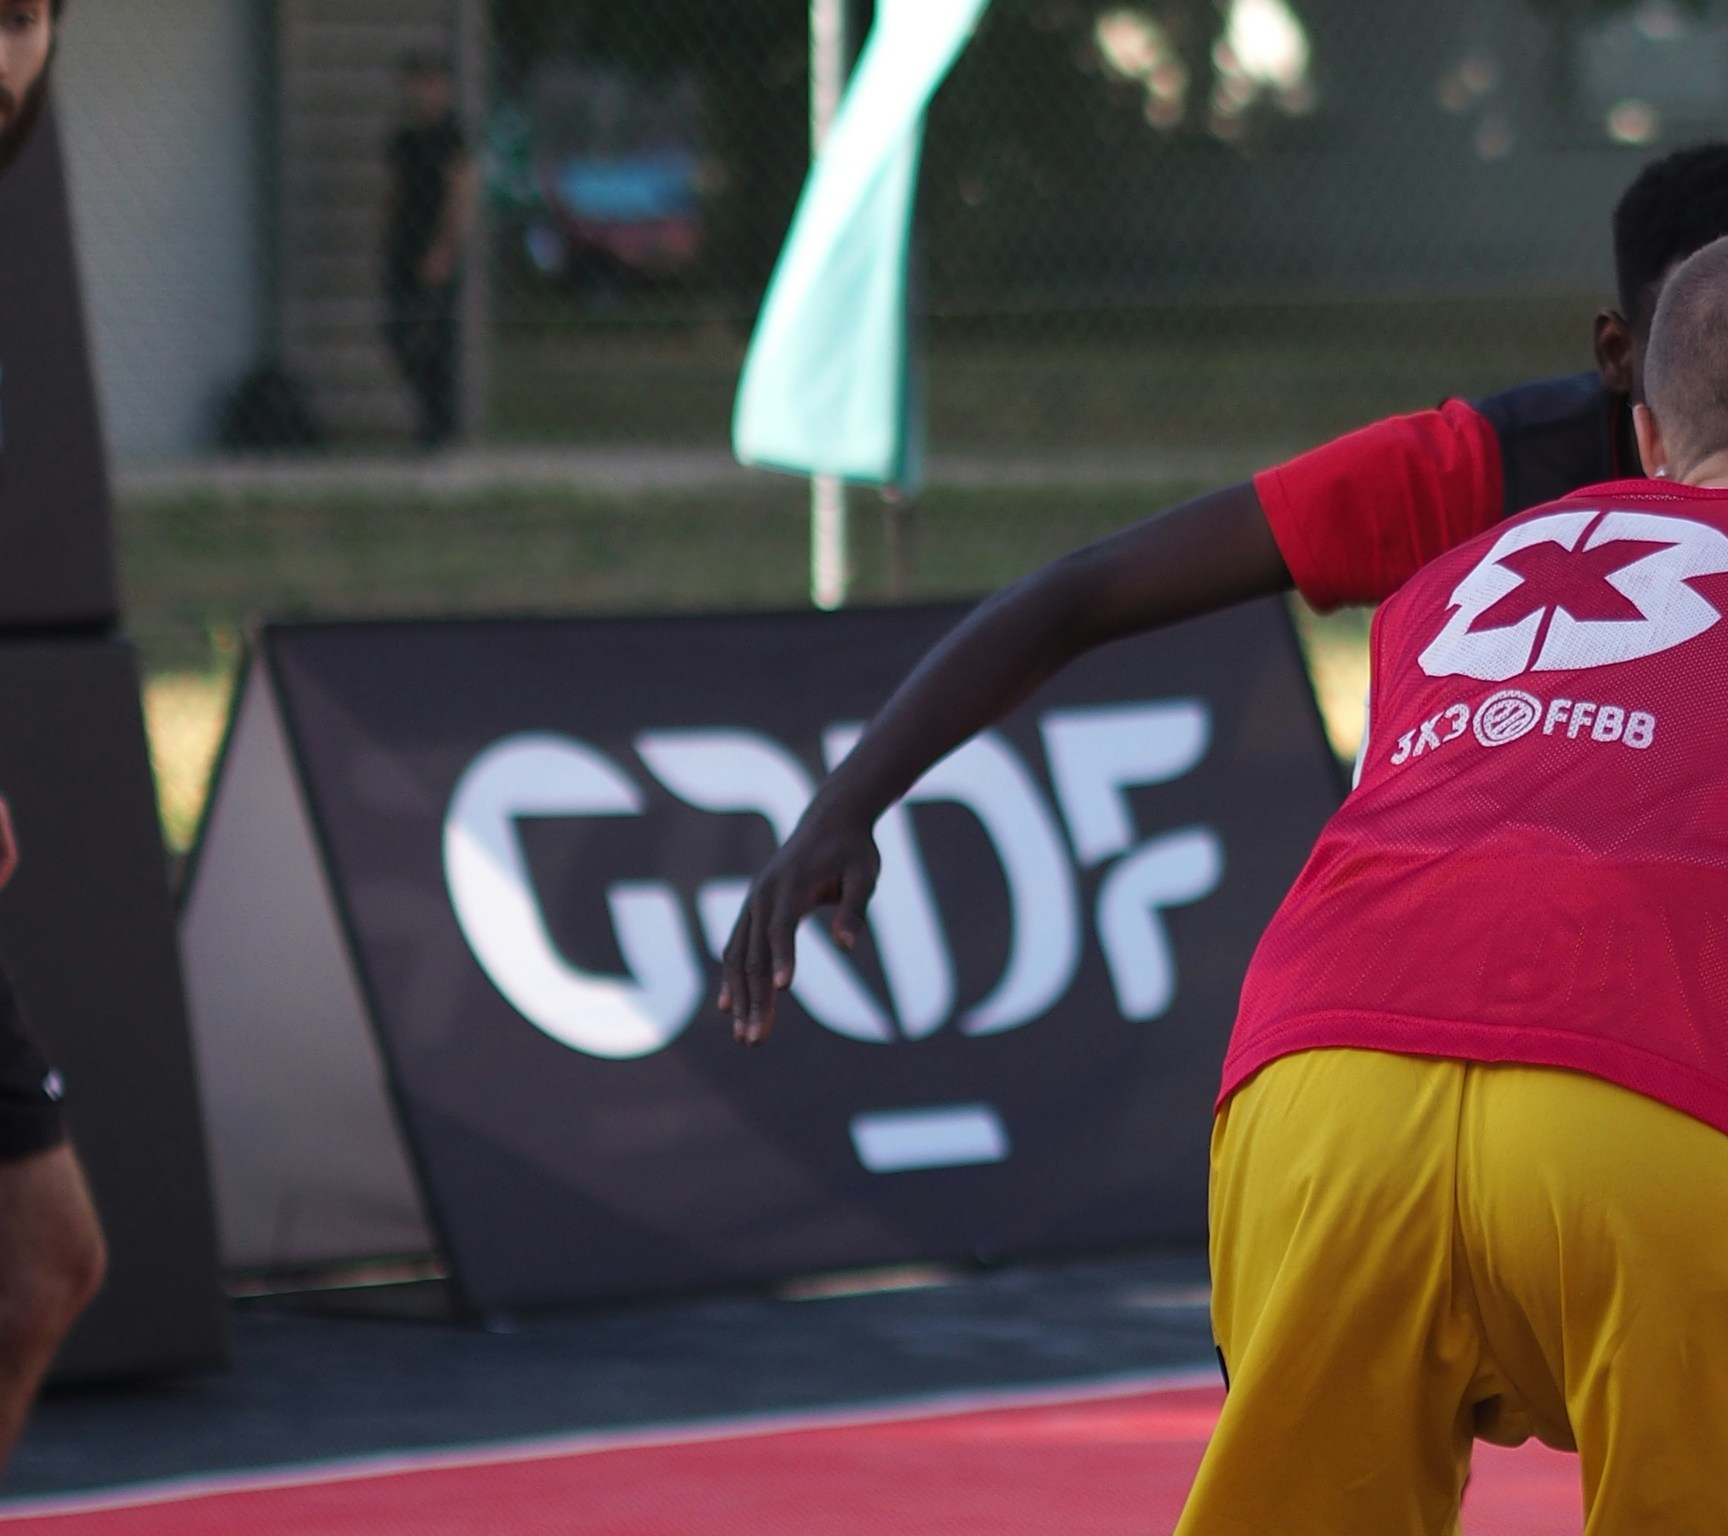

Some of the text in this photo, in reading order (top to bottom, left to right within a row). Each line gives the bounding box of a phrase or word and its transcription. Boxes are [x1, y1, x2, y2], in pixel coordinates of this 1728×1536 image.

[1390, 697, 1656, 765] 3X3 FFBB
[442, 697, 1223, 1058] GRDF
